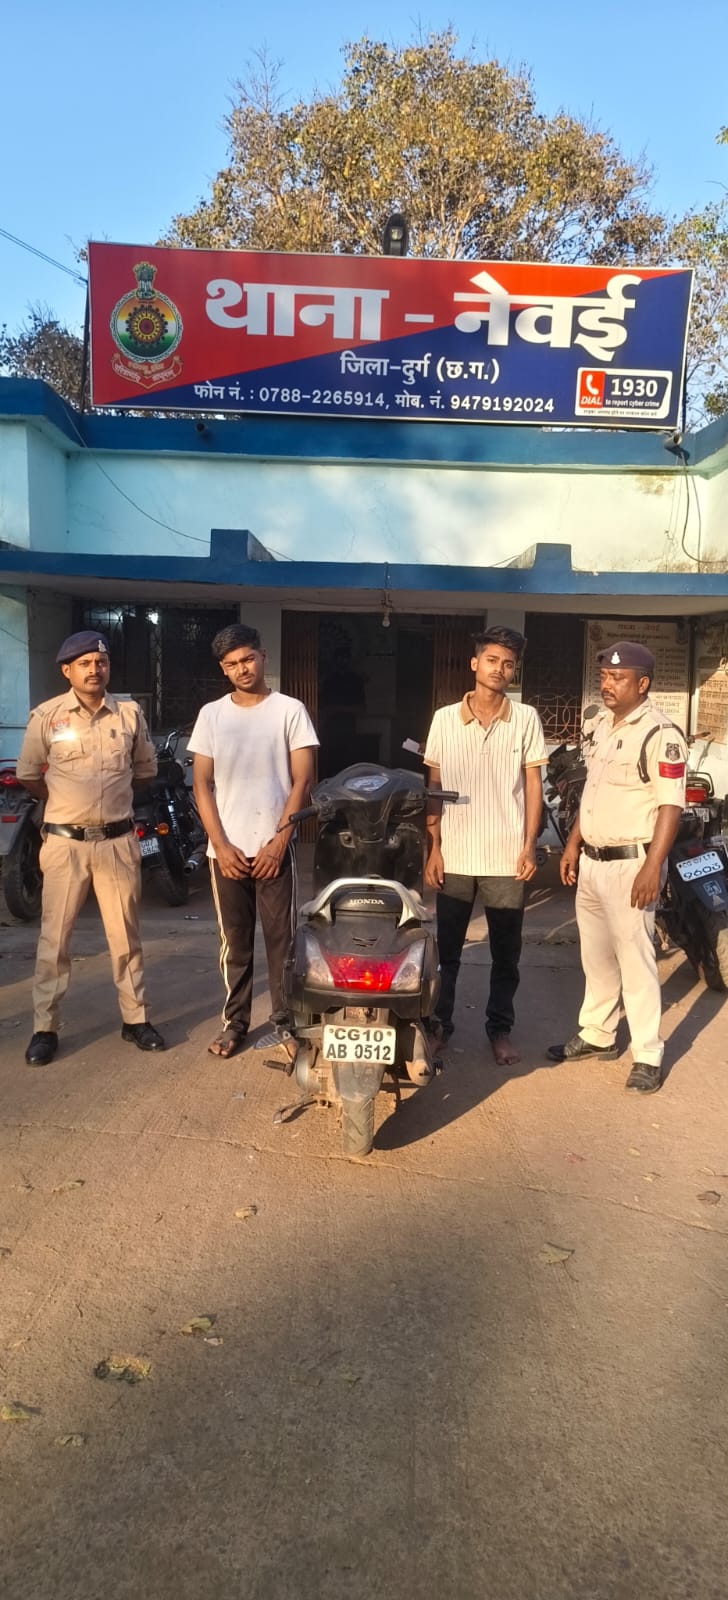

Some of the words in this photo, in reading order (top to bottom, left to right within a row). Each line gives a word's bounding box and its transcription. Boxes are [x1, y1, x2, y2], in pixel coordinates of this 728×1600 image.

[205, 278, 391, 341] थाना
[453, 271, 642, 362] नेवई
[340, 351, 431, 385] जिला-दुर्ग
[436, 357, 500, 384] (छ.ग.)
[194, 380, 225, 399] फोन
[228, 381, 245, 400] नं.
[259, 387, 390, 410] 0788-2265914,
[395, 390, 425, 409] मोब.
[429, 390, 445, 409] नं.
[450, 395, 554, 413] 9479192024
[611, 378, 658, 397] 1930
[581, 395, 602, 405] DIAL
[629, 400, 644, 408] cyber
[349, 898, 385, 906] HONDA
[326, 1043, 348, 1060] AB
[354, 1044, 391, 1061] 0512
